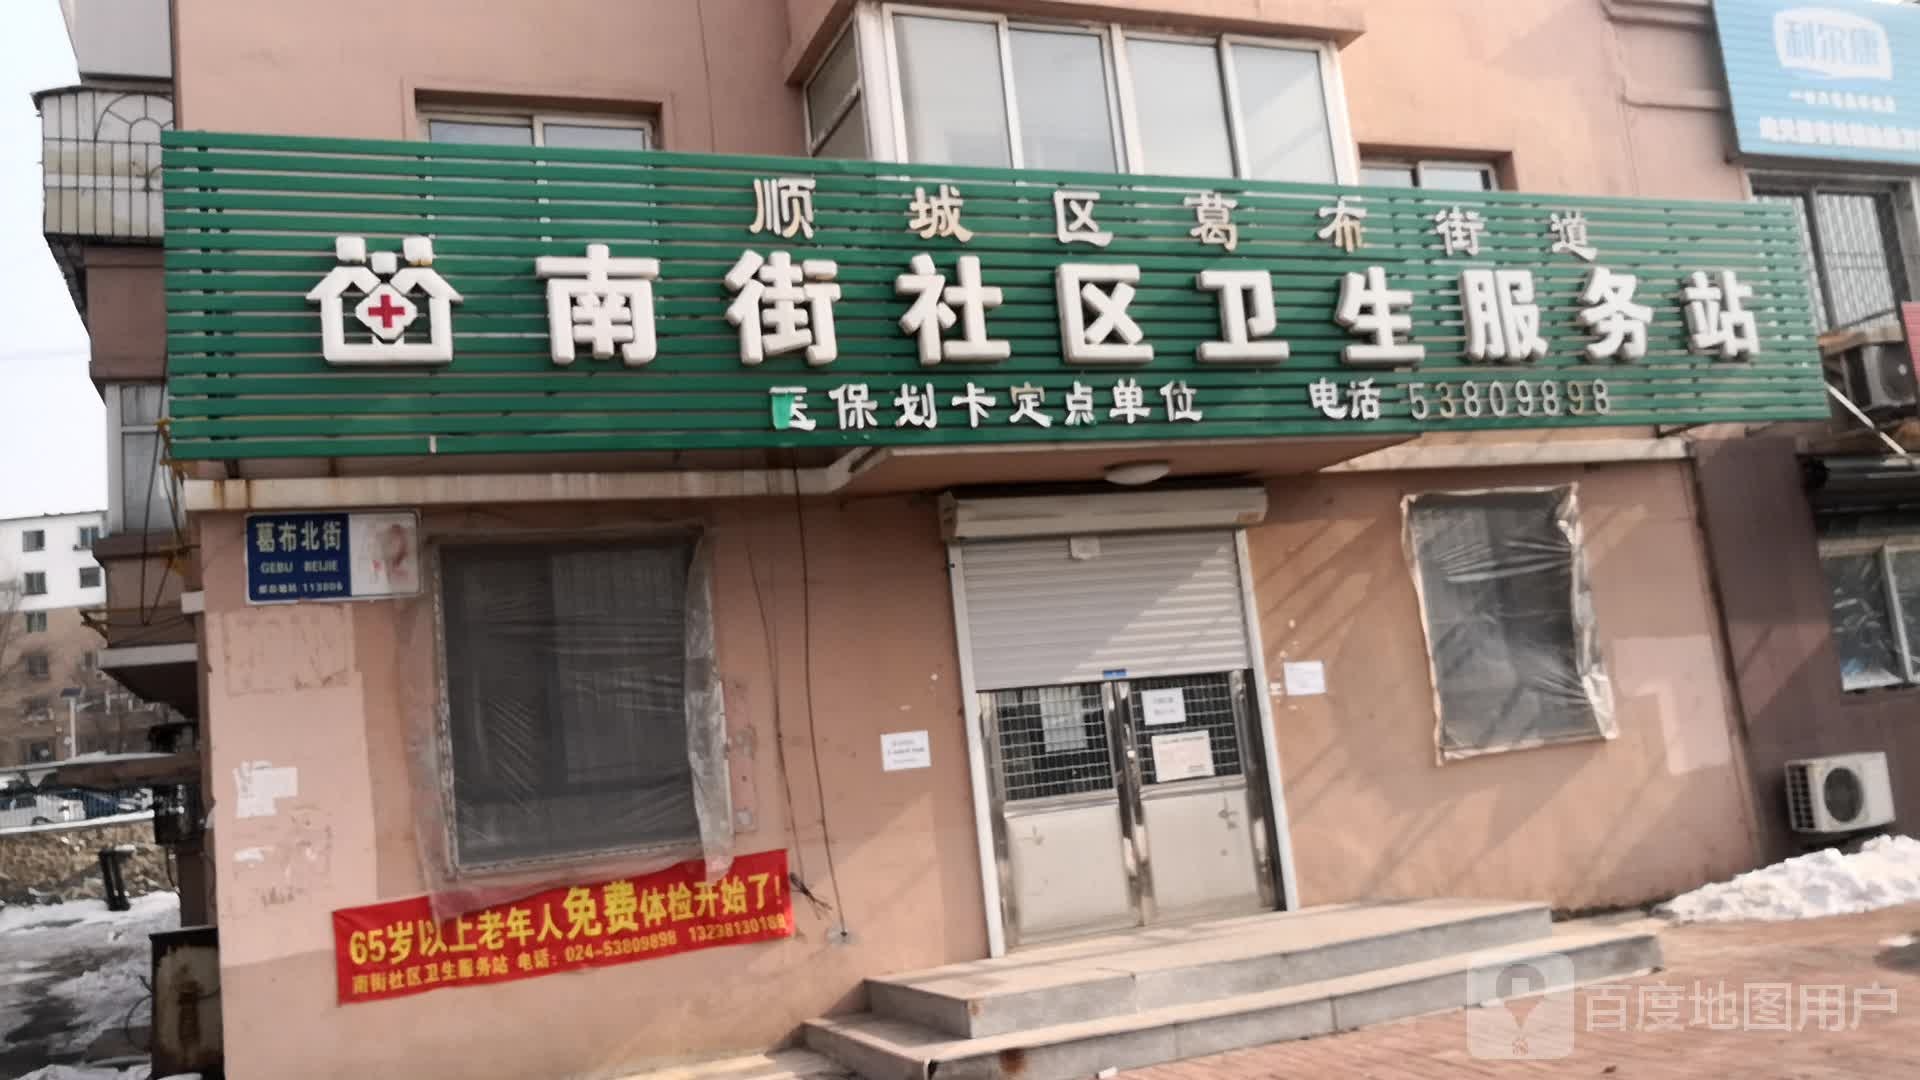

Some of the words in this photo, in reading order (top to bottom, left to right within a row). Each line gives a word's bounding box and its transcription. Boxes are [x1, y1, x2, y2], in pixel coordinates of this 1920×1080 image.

[749, 177, 1597, 262] 顺城区葛布街道
[535, 243, 1761, 365] 南街社区卫生服务站
[769, 378, 1203, 431] 医保划卡定点单位
[1307, 377, 1382, 420] 电话
[1408, 378, 1611, 420] 53809898
[255, 520, 342, 552] 葛布北街
[261, 561, 293, 573] GEBU
[304, 560, 337, 573] BEIJIE
[349, 873, 783, 965] 65岁以上老年人免费体检开始了!
[352, 954, 508, 994] 南街社区卫生服务站
